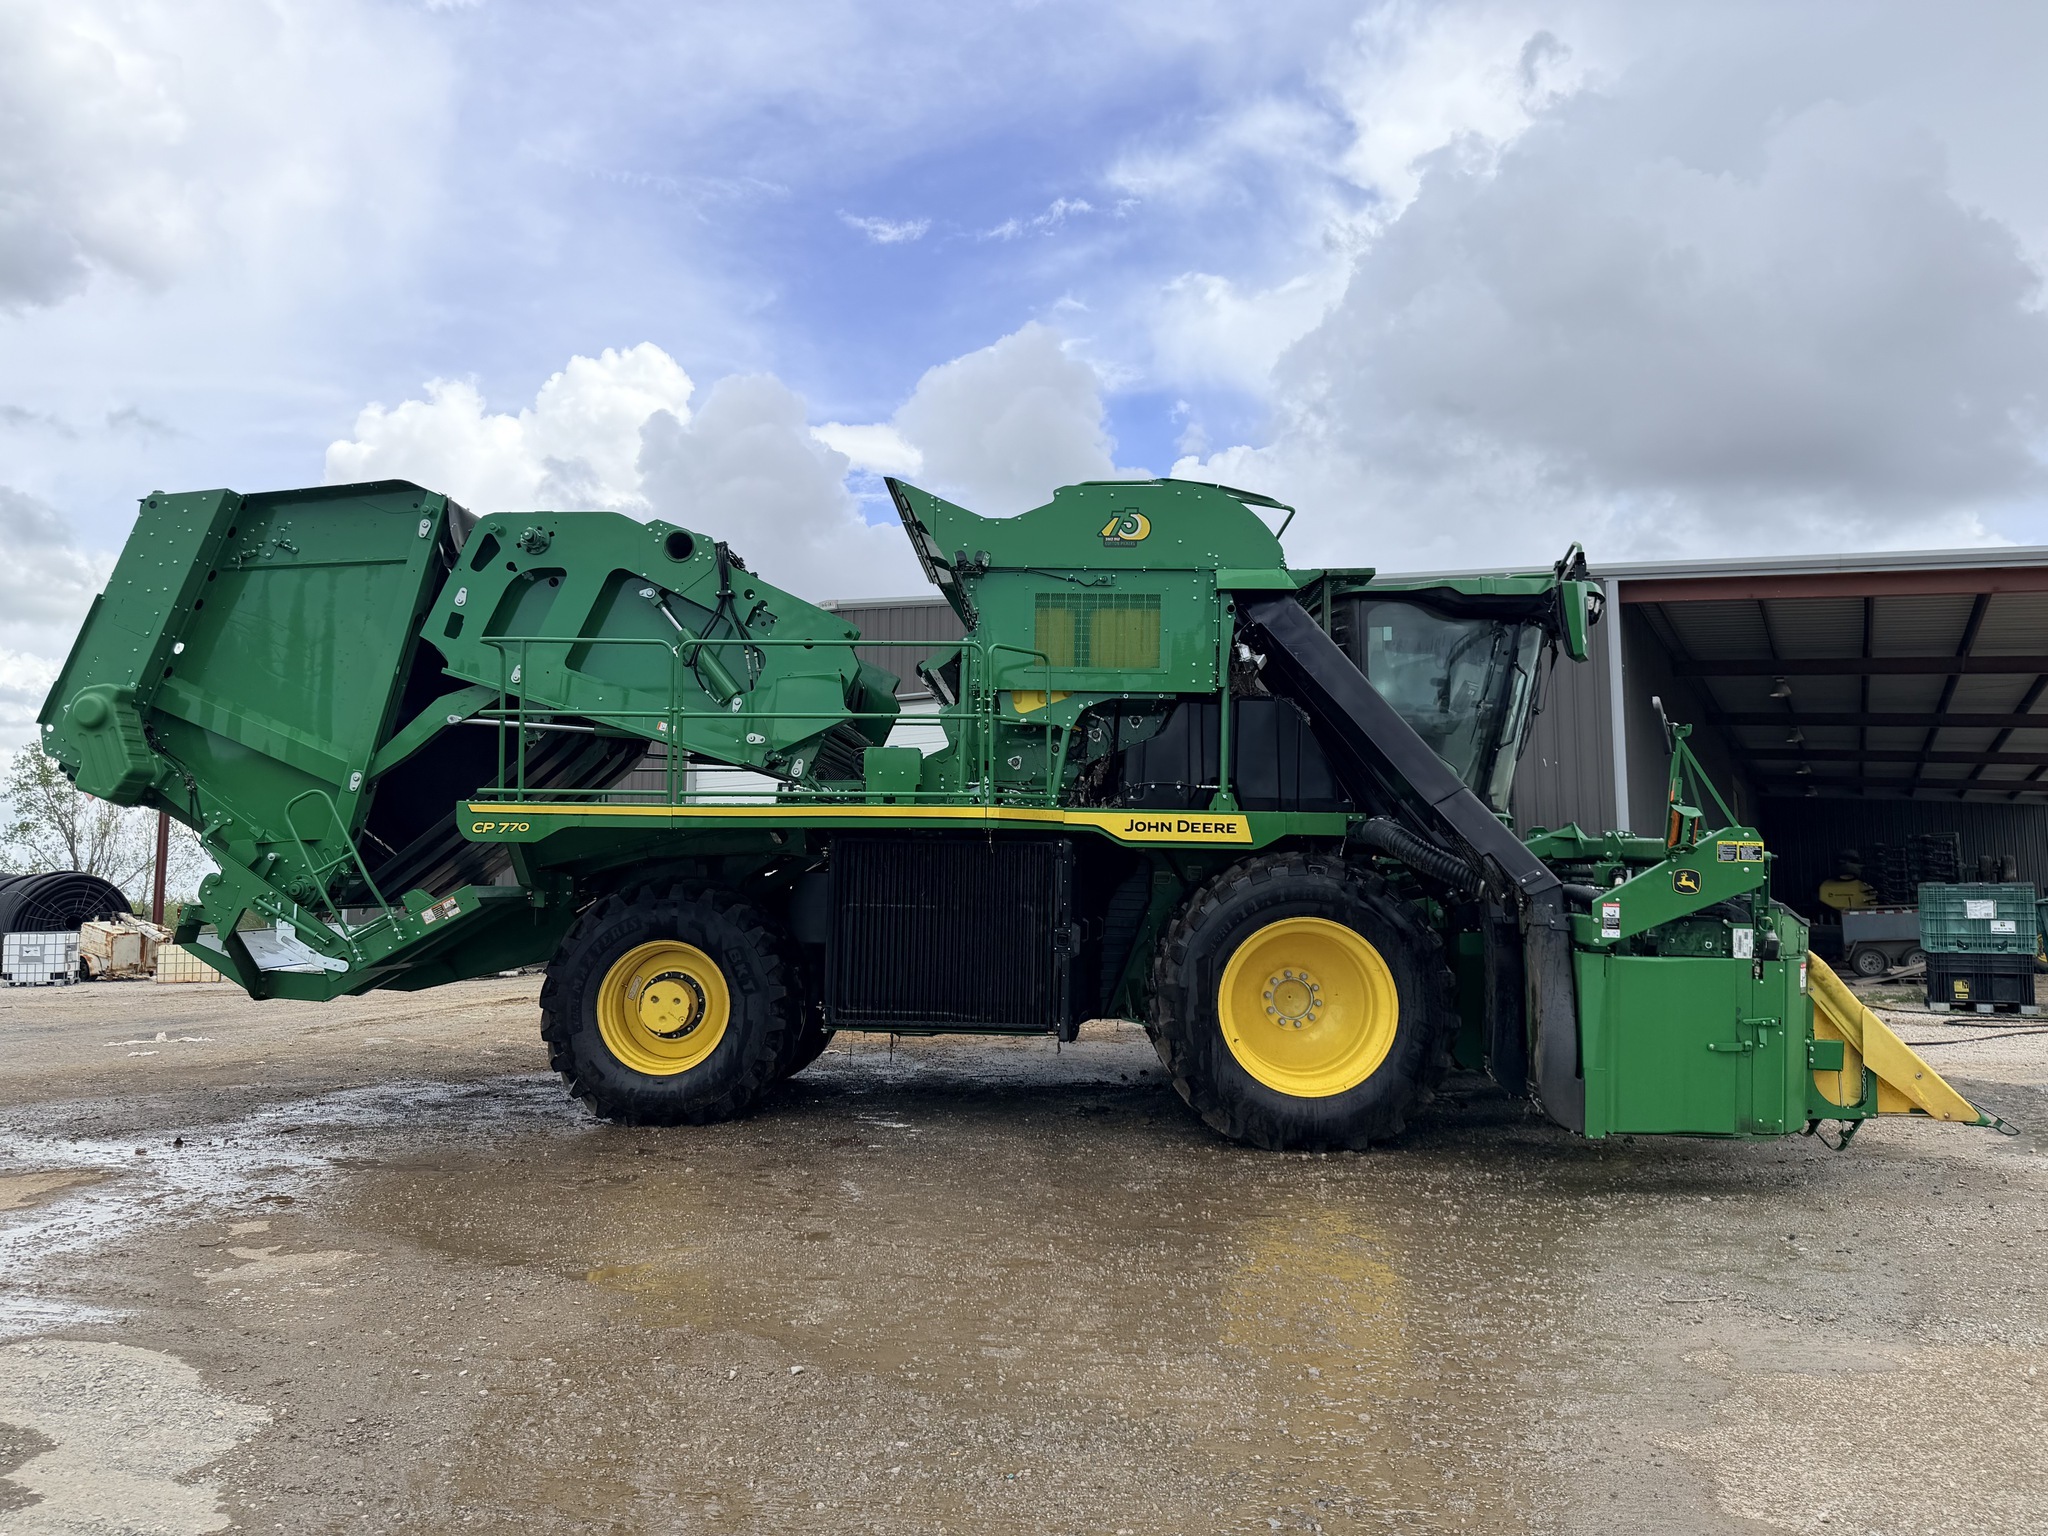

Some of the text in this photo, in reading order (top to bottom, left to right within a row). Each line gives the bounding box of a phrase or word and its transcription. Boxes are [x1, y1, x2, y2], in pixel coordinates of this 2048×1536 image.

[471, 822, 530, 834] CP 770
[728, 949, 756, 992] BKT
